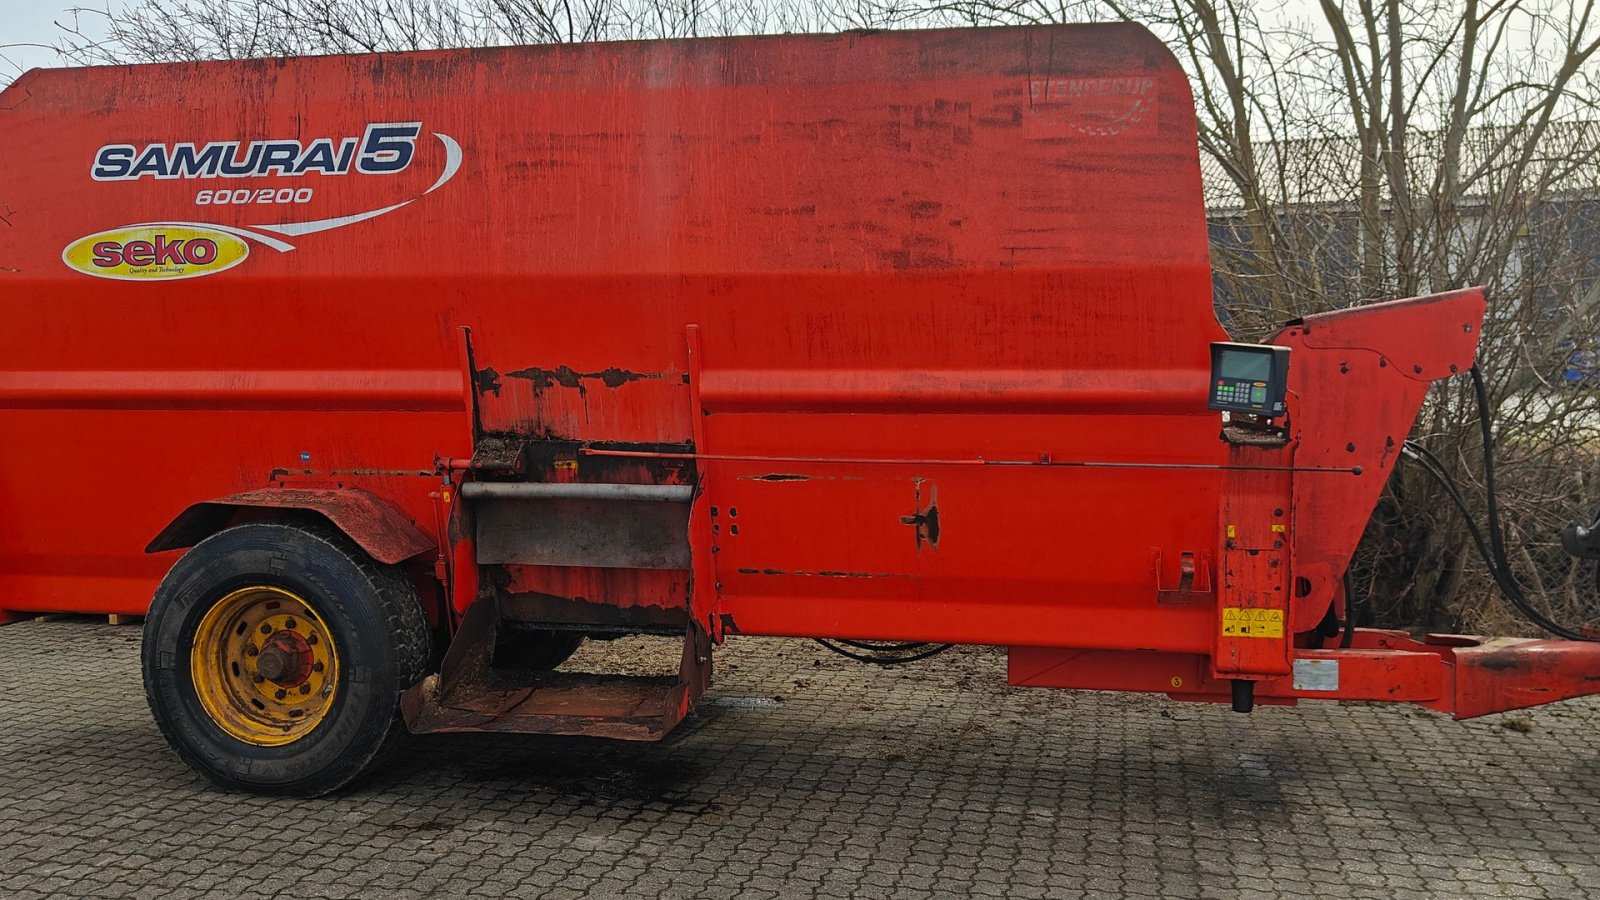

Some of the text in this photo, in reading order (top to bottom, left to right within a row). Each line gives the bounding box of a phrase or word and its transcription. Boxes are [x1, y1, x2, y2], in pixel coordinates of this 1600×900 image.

[91, 121, 422, 181] SAMURAI 5
[195, 188, 314, 206] 600/200
[92, 235, 218, 266] seko
